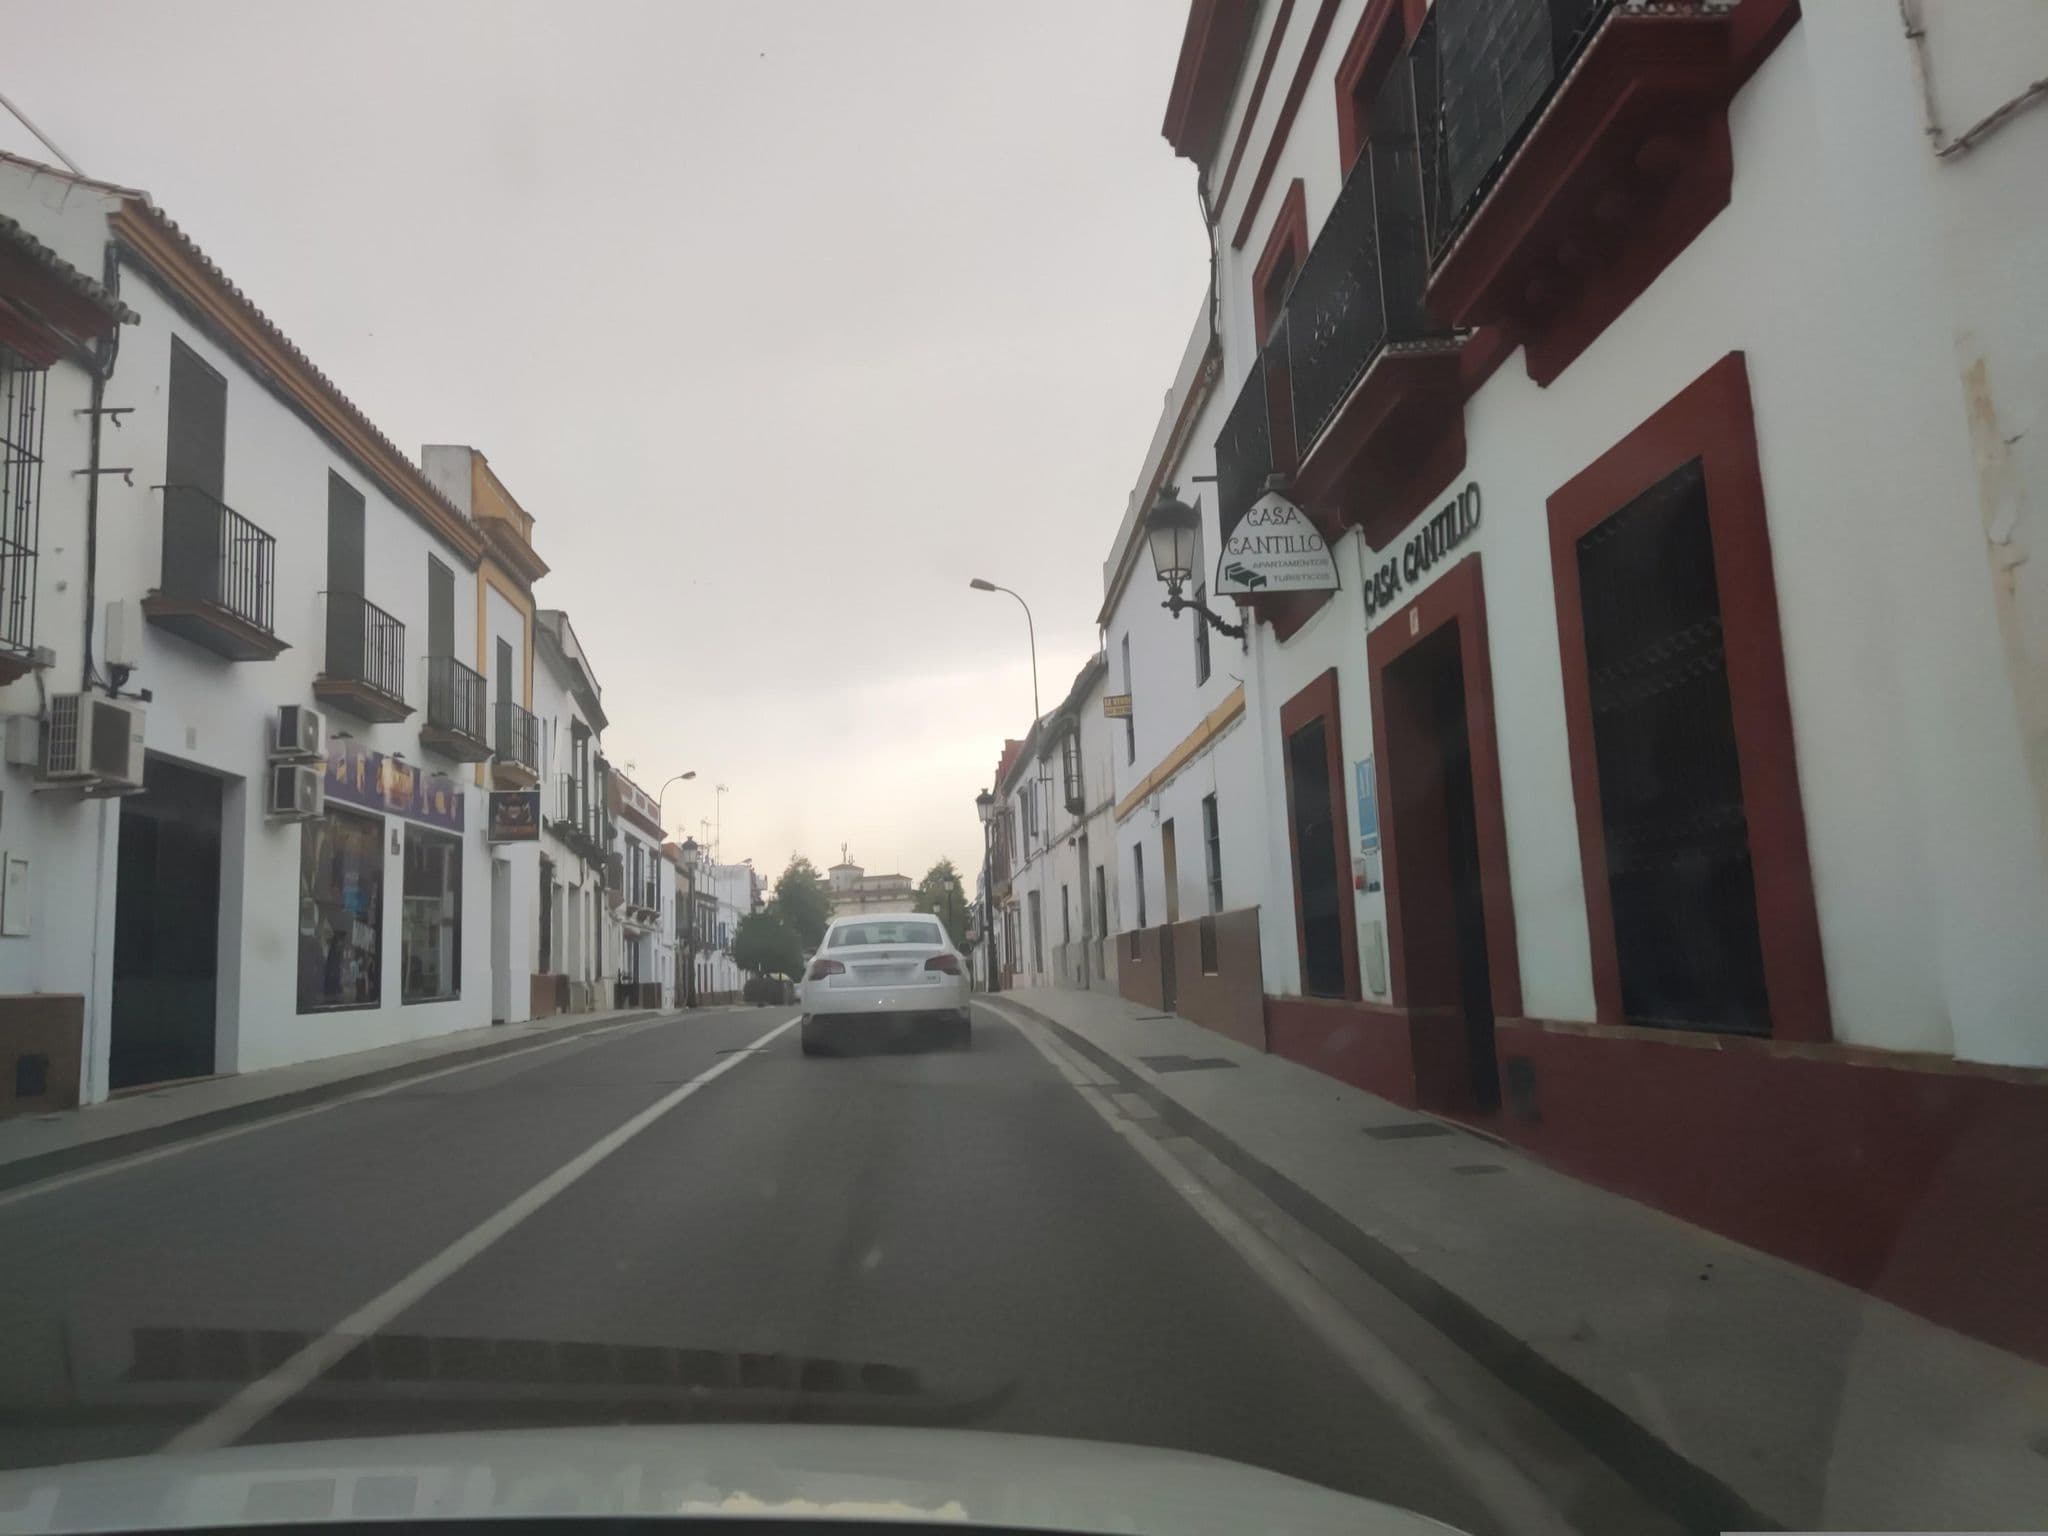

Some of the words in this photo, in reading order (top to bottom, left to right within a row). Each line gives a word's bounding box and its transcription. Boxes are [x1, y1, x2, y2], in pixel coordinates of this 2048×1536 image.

[1246, 506, 1302, 527] CASA
[1227, 534, 1324, 556] CANTILLO
[1364, 556, 1403, 618] CASA
[1403, 481, 1482, 585] CANTILLO
